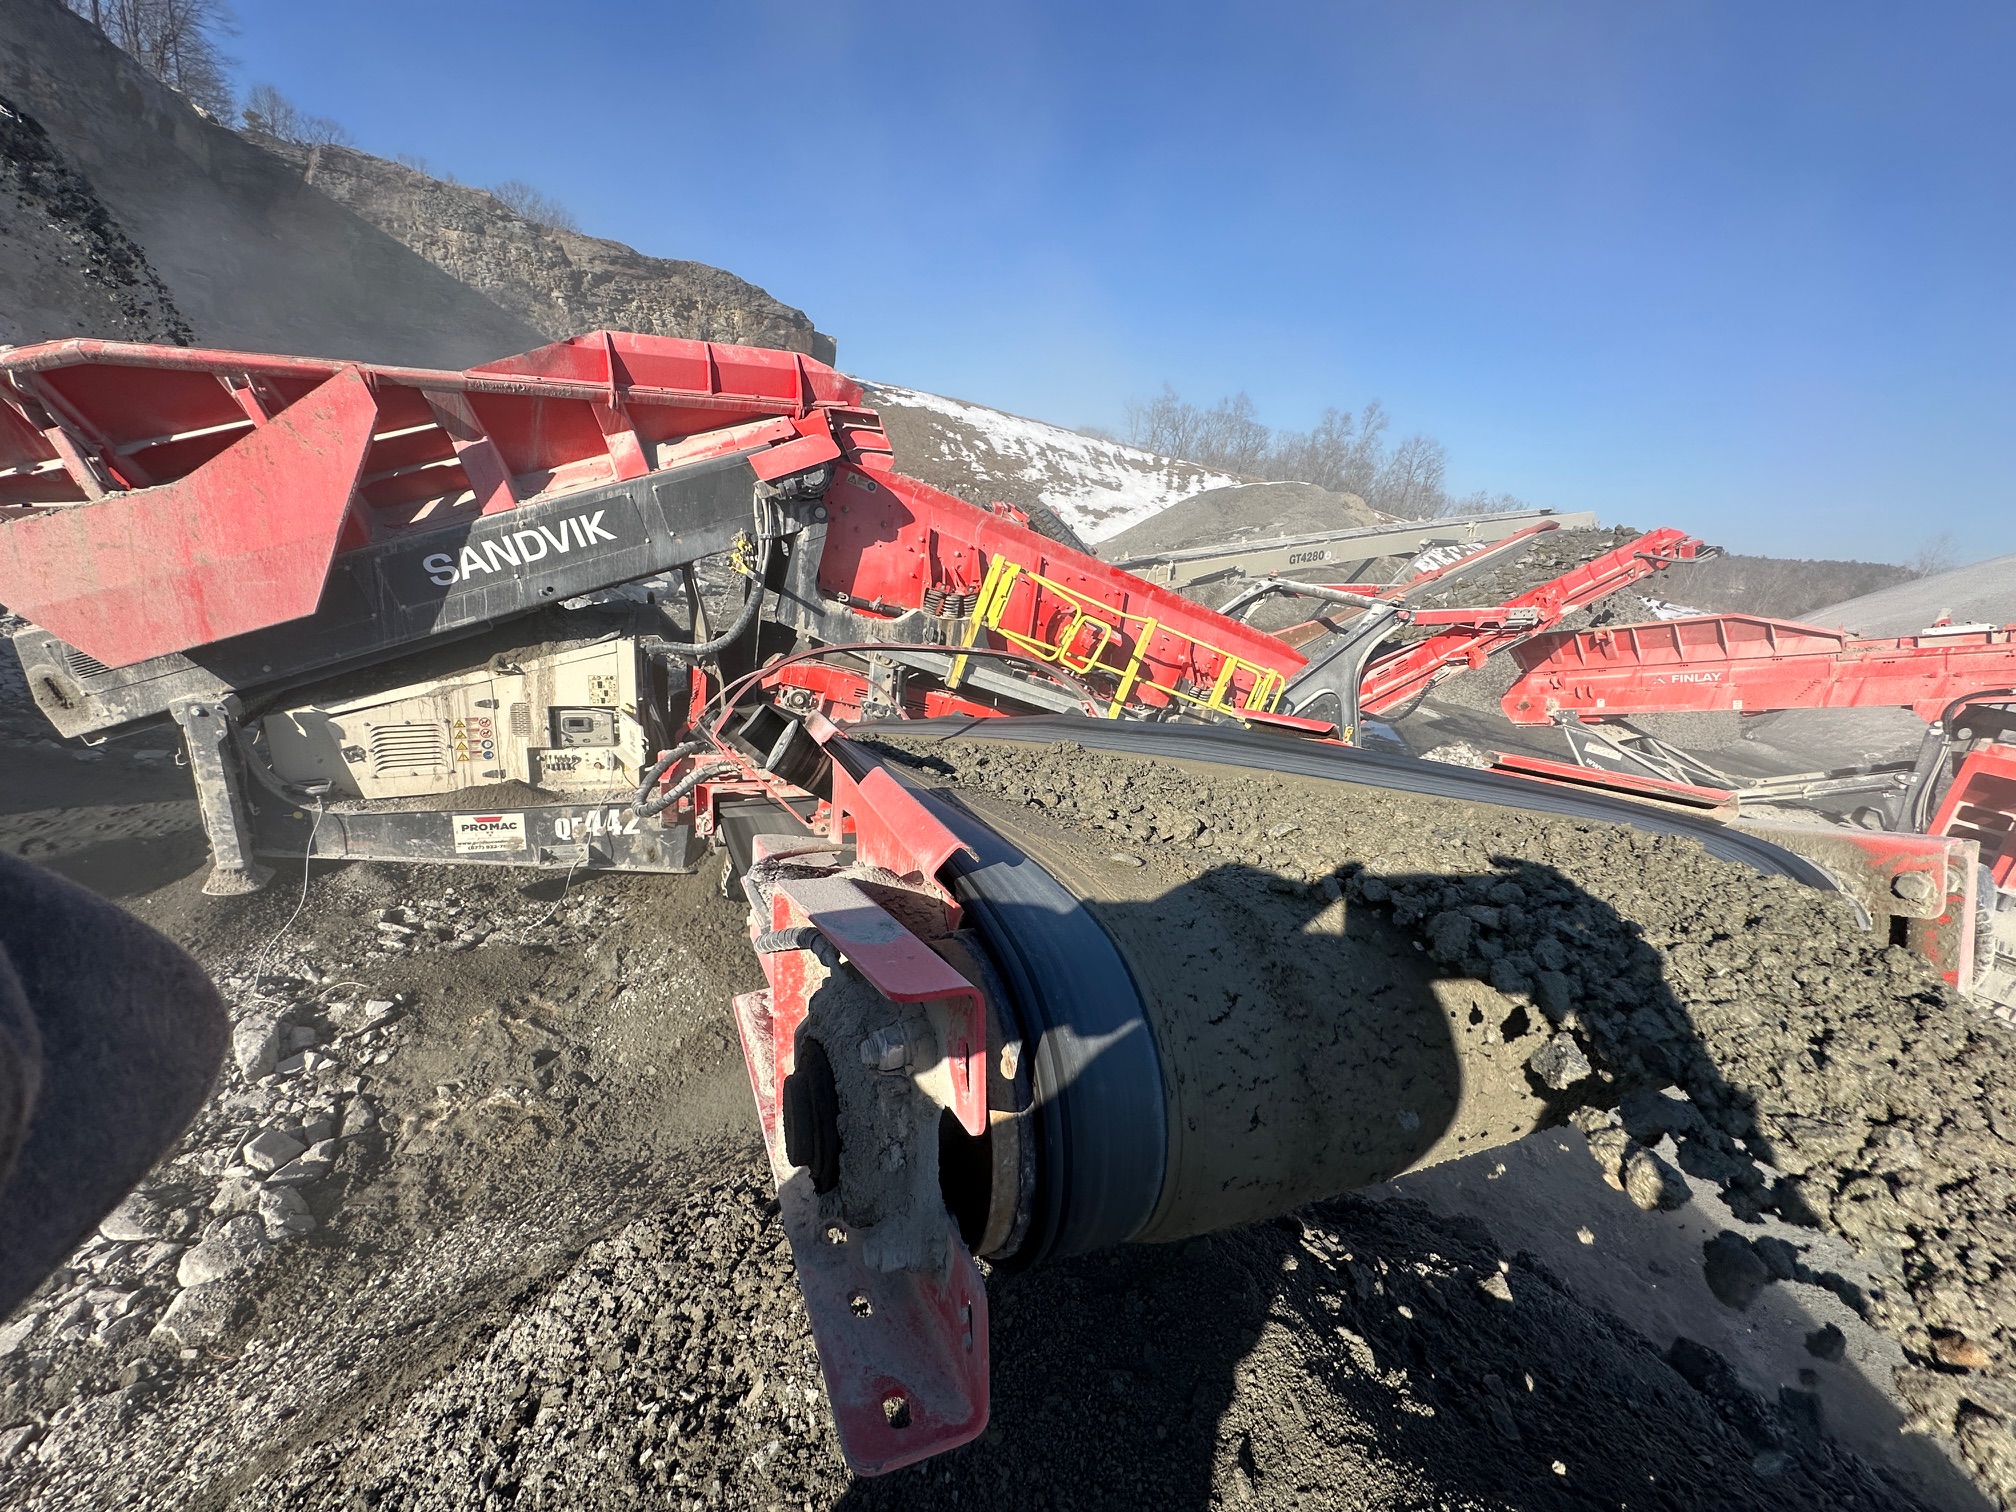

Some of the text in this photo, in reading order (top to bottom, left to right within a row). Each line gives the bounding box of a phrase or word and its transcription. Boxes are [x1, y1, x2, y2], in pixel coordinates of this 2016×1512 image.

[422, 509, 618, 586] SANDVIK
[1289, 550, 1325, 565] GT4280
[1671, 672, 1722, 684] FINLAY
